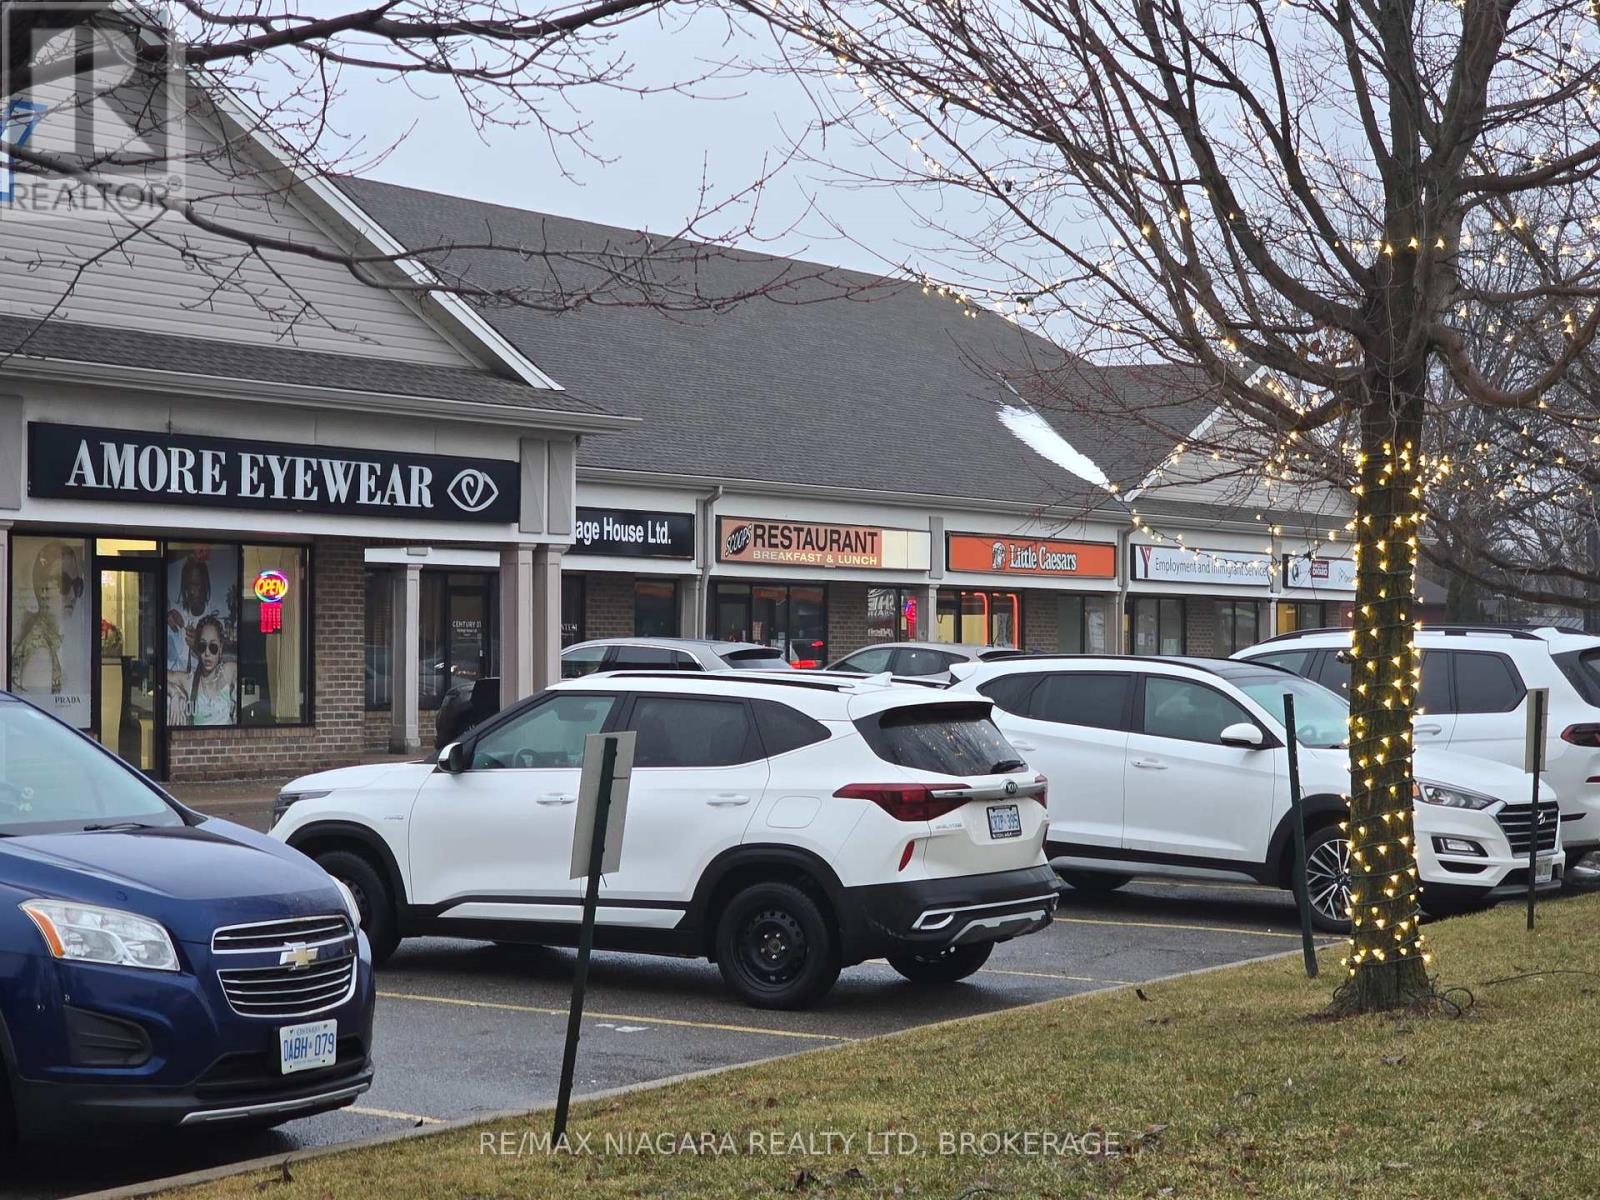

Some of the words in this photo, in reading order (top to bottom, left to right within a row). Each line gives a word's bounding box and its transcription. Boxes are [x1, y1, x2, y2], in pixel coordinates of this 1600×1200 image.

[65, 439, 226, 496] AMORE
[237, 452, 434, 508] EYEWEAR
[576, 520, 599, 545] age
[603, 516, 644, 543] House
[647, 520, 672, 545] Ltd.
[753, 524, 878, 554] RESTAURANT
[753, 550, 821, 563] BREAKFAST
[827, 554, 834, 564] &
[838, 555, 878, 566] LUNCH
[1009, 544, 1038, 569] Little
[1039, 546, 1078, 571] Caesars
[1155, 557, 1197, 576] Employment
[1198, 562, 1211, 574] and
[257, 578, 285, 596] OPEN
[54, 695, 81, 704] PRADA
